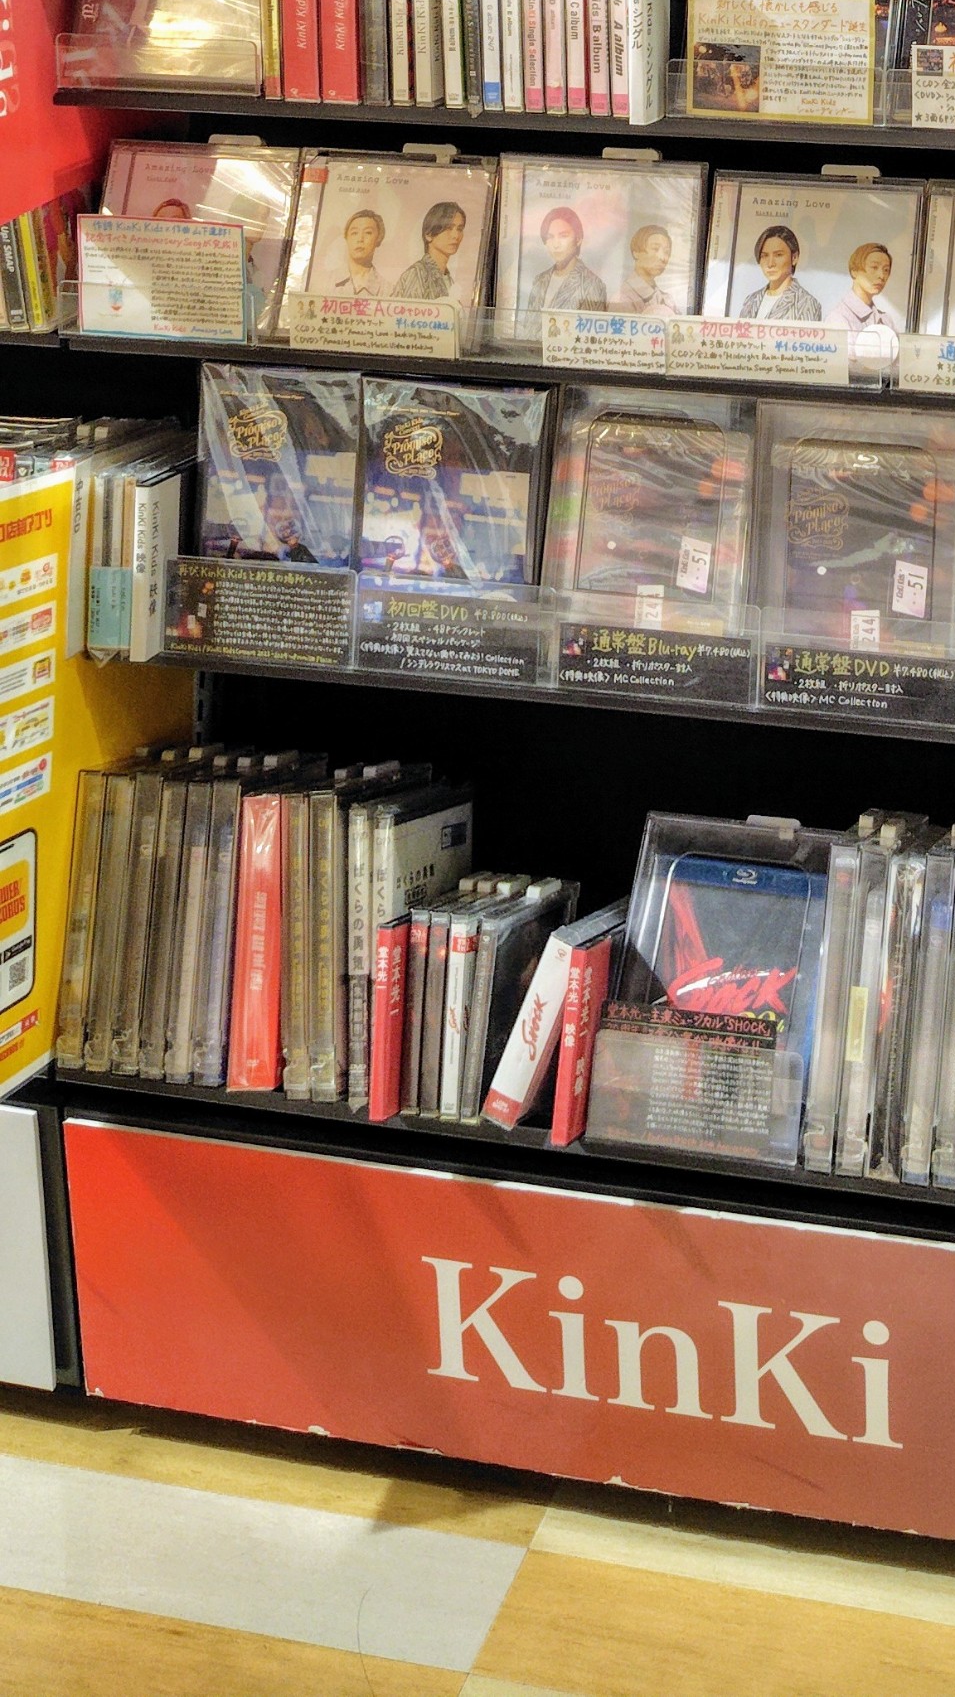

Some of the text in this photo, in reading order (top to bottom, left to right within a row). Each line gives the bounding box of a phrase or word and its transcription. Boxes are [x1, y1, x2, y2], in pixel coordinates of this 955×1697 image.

[593, 24, 601, 33] B
[614, 21, 623, 30] A
[631, 10, 642, 49] シングル
[698, 13, 729, 26] KinKi
[296, 24, 306, 48] KinKi
[335, 25, 345, 51] KinKi
[593, 36, 601, 73] album
[614, 34, 623, 77] album
[337, 174, 409, 185] Amazing Love
[536, 179, 611, 191] Amazing Love
[752, 197, 831, 209] Amazing Love
[391, 433, 434, 455] Promise
[402, 448, 436, 466] Place
[135, 502, 148, 574] KinKi Kids 映像
[376, 944, 390, 991] 堂本光一
[563, 965, 582, 1048] 堂本光一 映像
[420, 1255, 905, 1451] KinKi
